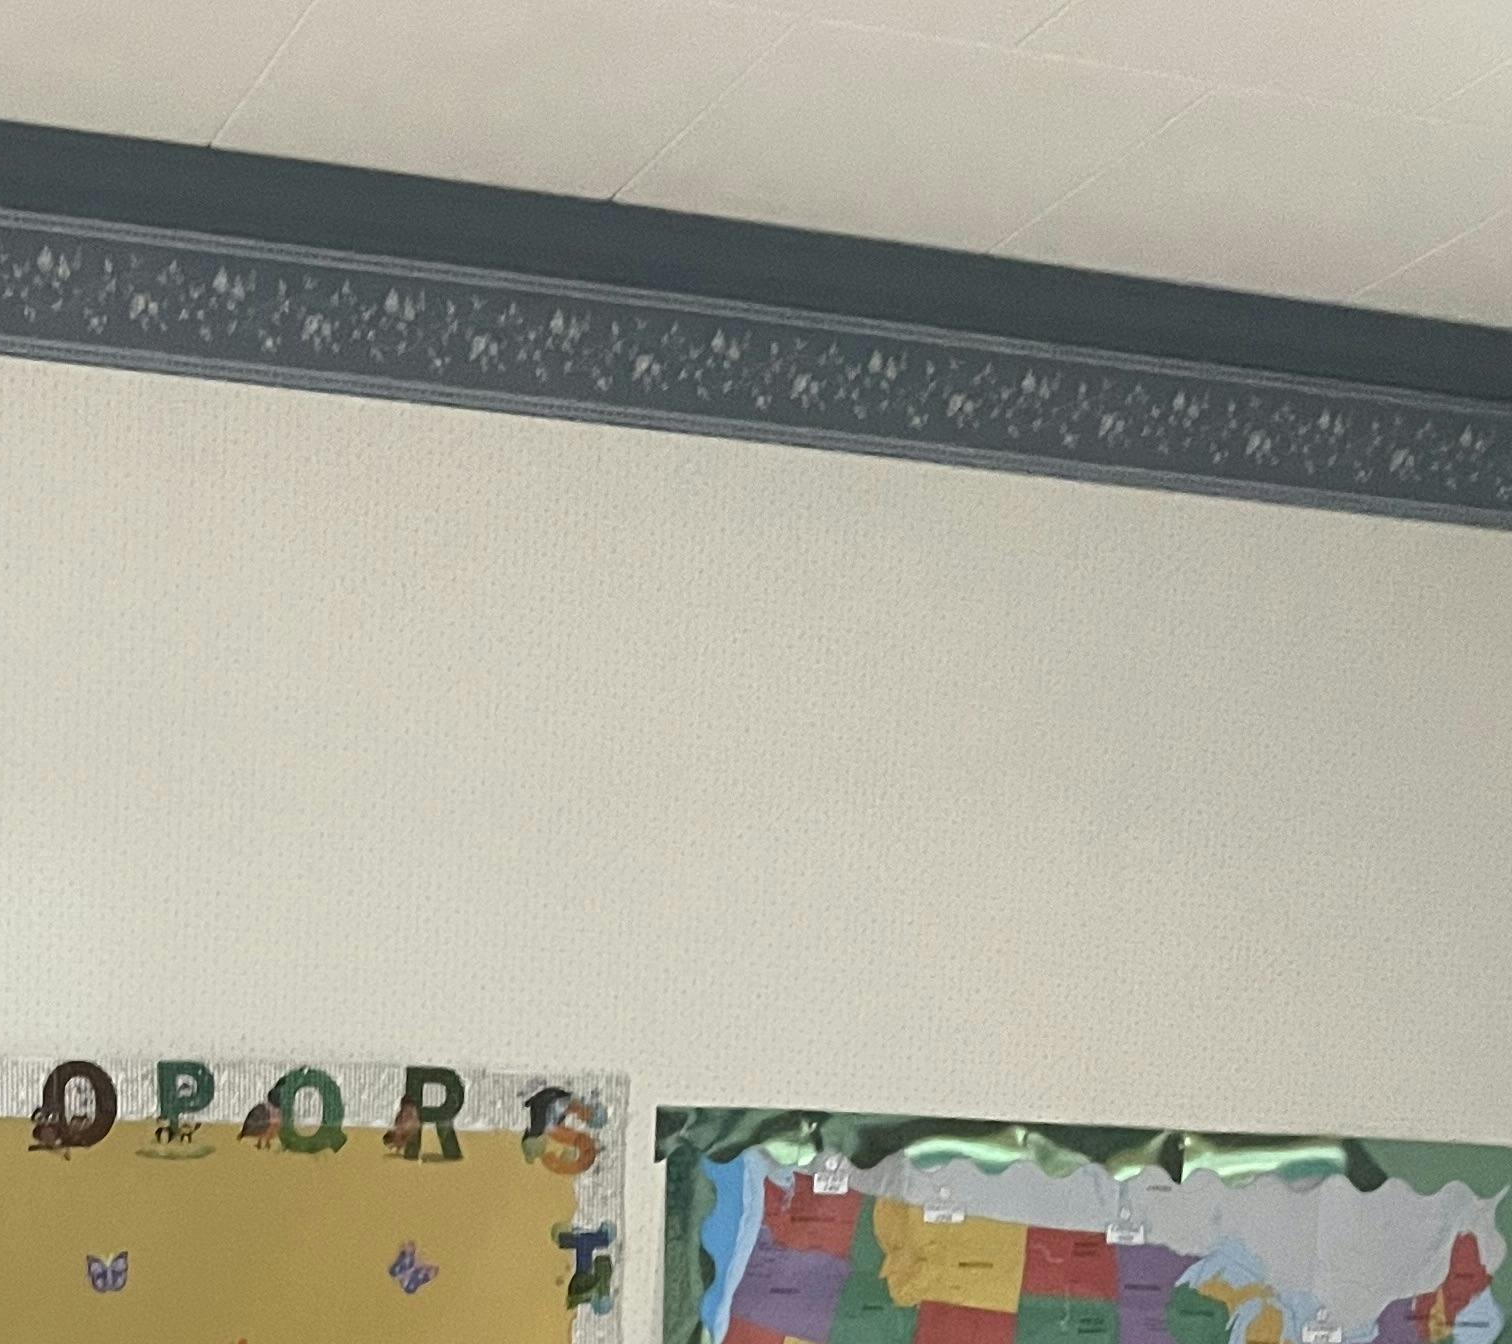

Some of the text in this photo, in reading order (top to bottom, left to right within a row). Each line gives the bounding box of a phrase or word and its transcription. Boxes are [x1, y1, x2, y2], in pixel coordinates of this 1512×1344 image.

[42, 1060, 117, 1148] O
[157, 1060, 215, 1143] P
[271, 1066, 347, 1153] Q
[405, 1066, 465, 1160] R
[536, 1097, 596, 1175] S
